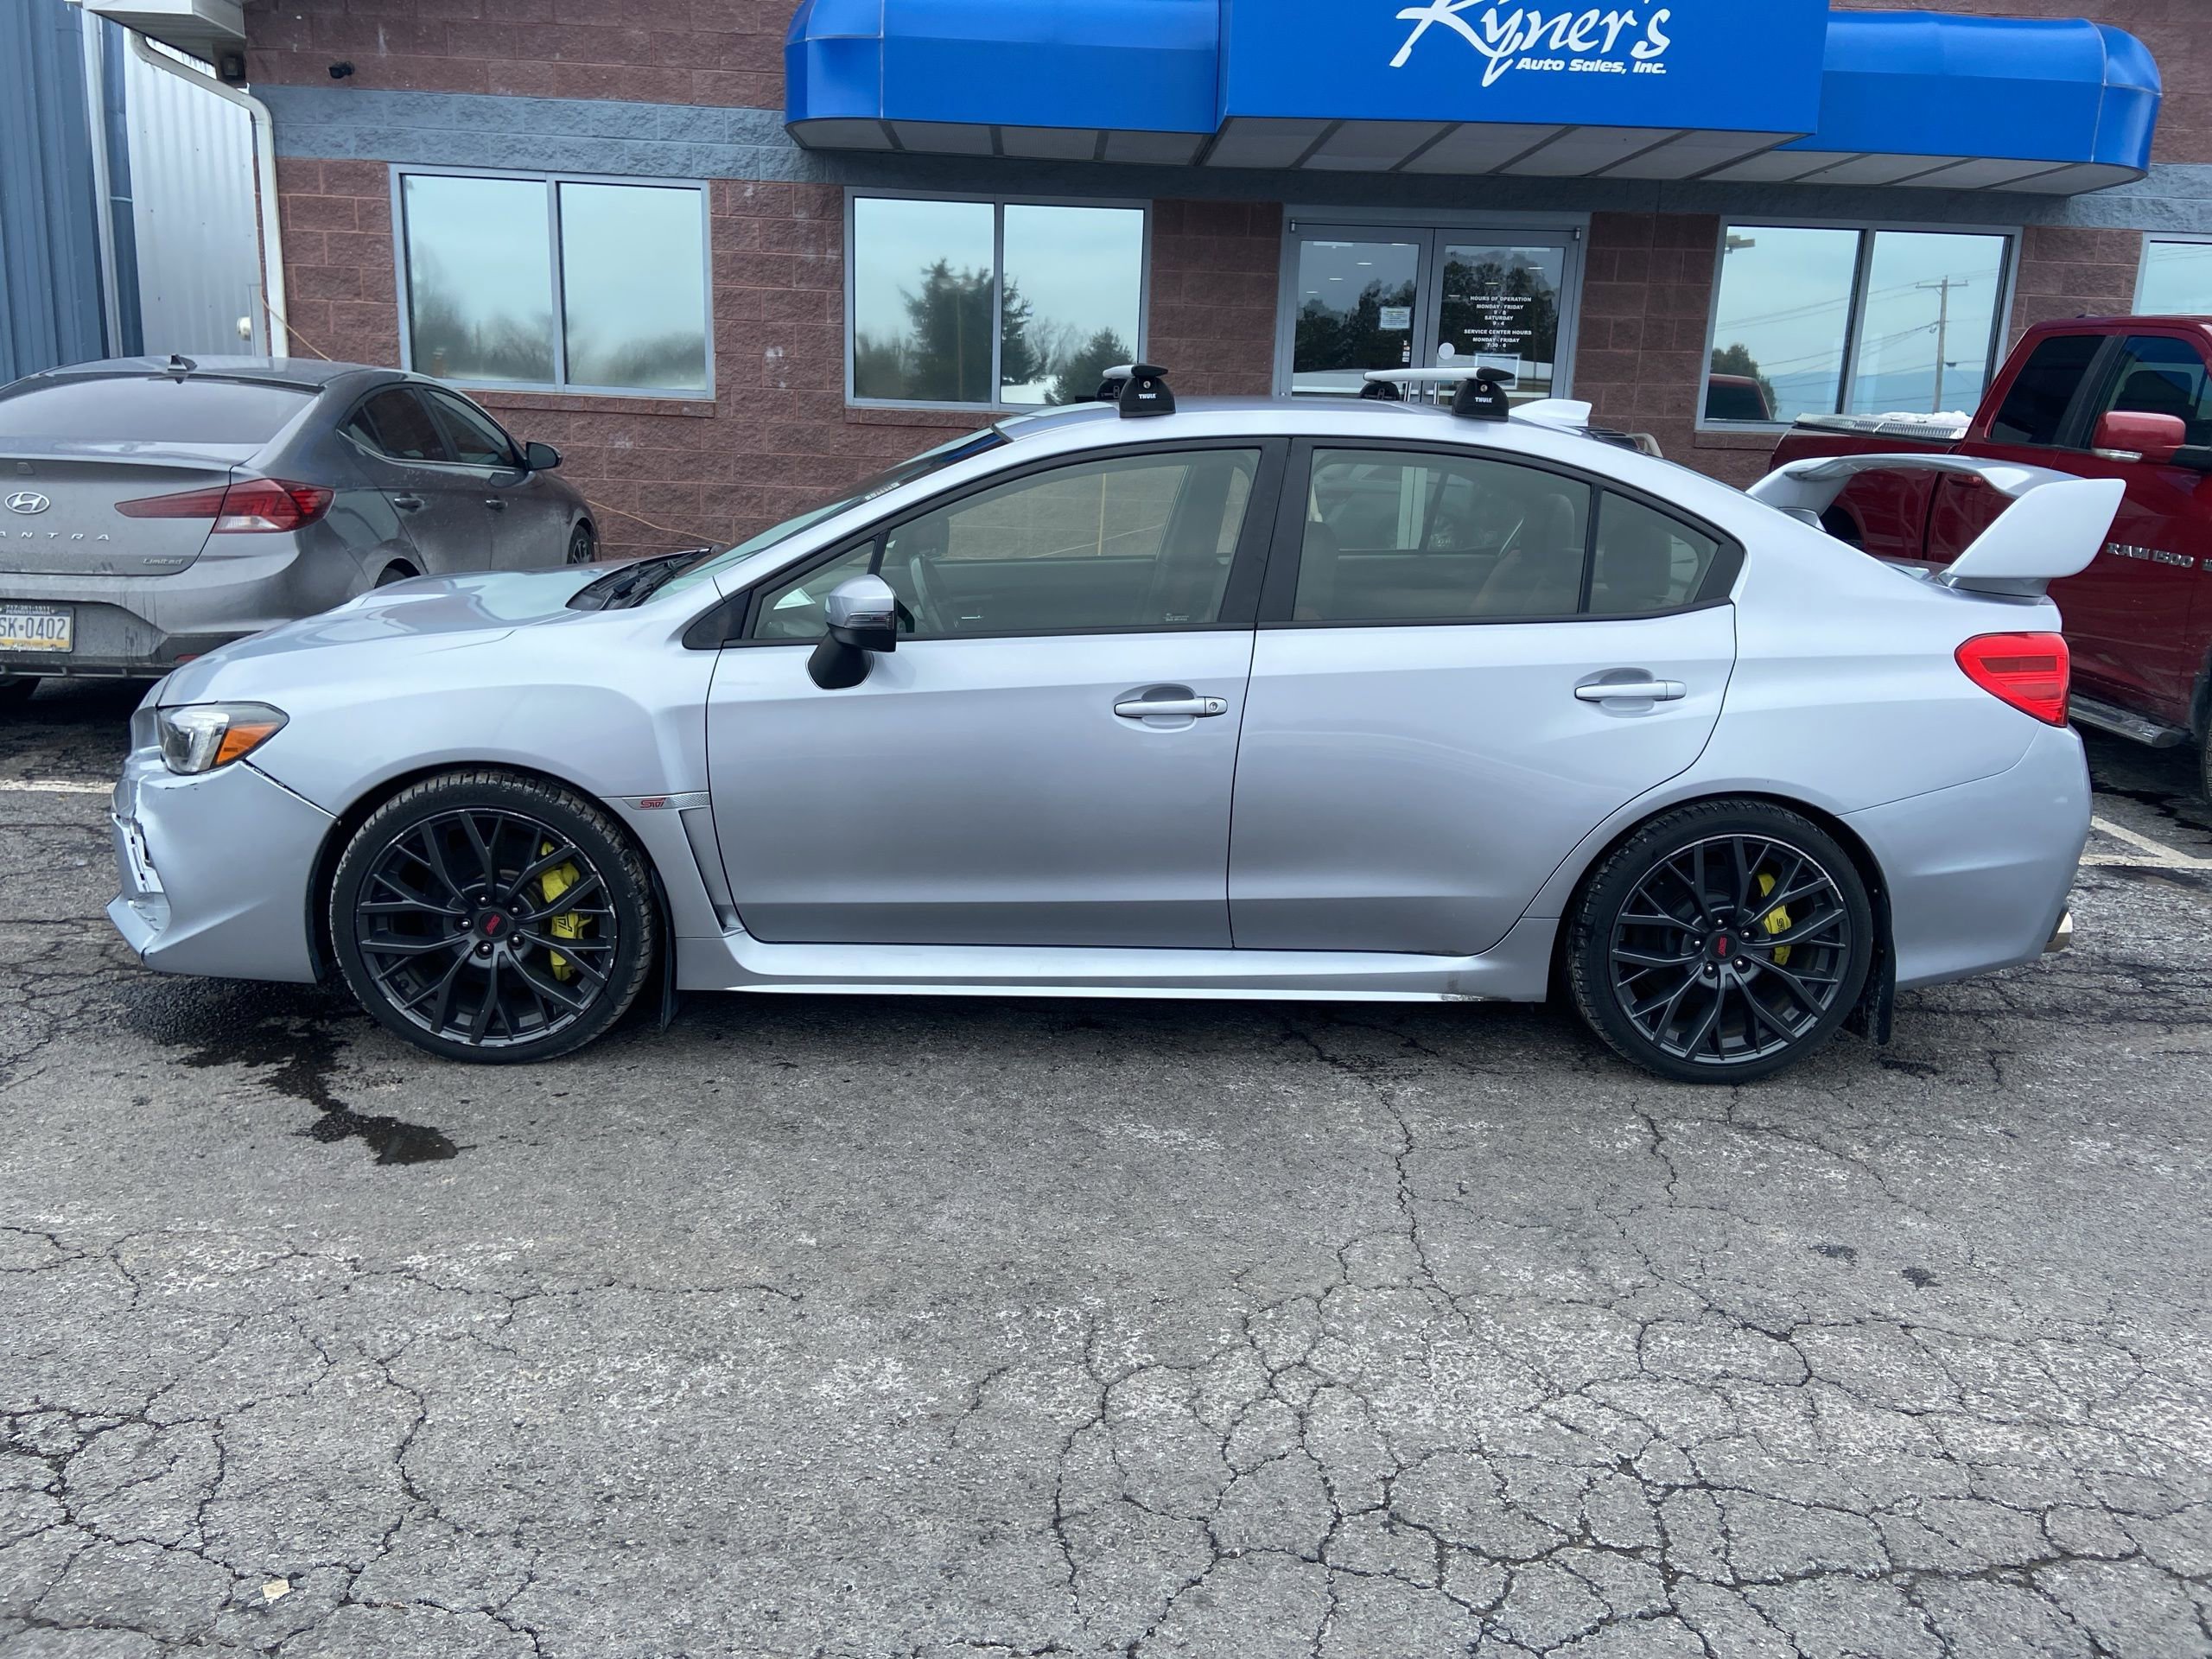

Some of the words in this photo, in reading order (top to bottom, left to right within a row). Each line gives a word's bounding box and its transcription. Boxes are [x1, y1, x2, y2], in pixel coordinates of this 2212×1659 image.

[1389, 0, 1672, 87] Kyners
[1516, 57, 1565, 72] Auto
[1568, 58, 1628, 74] Sales,
[1632, 60, 1668, 74] Inc.
[2107, 543, 2151, 560] RAM
[2152, 550, 2194, 569] 1500
